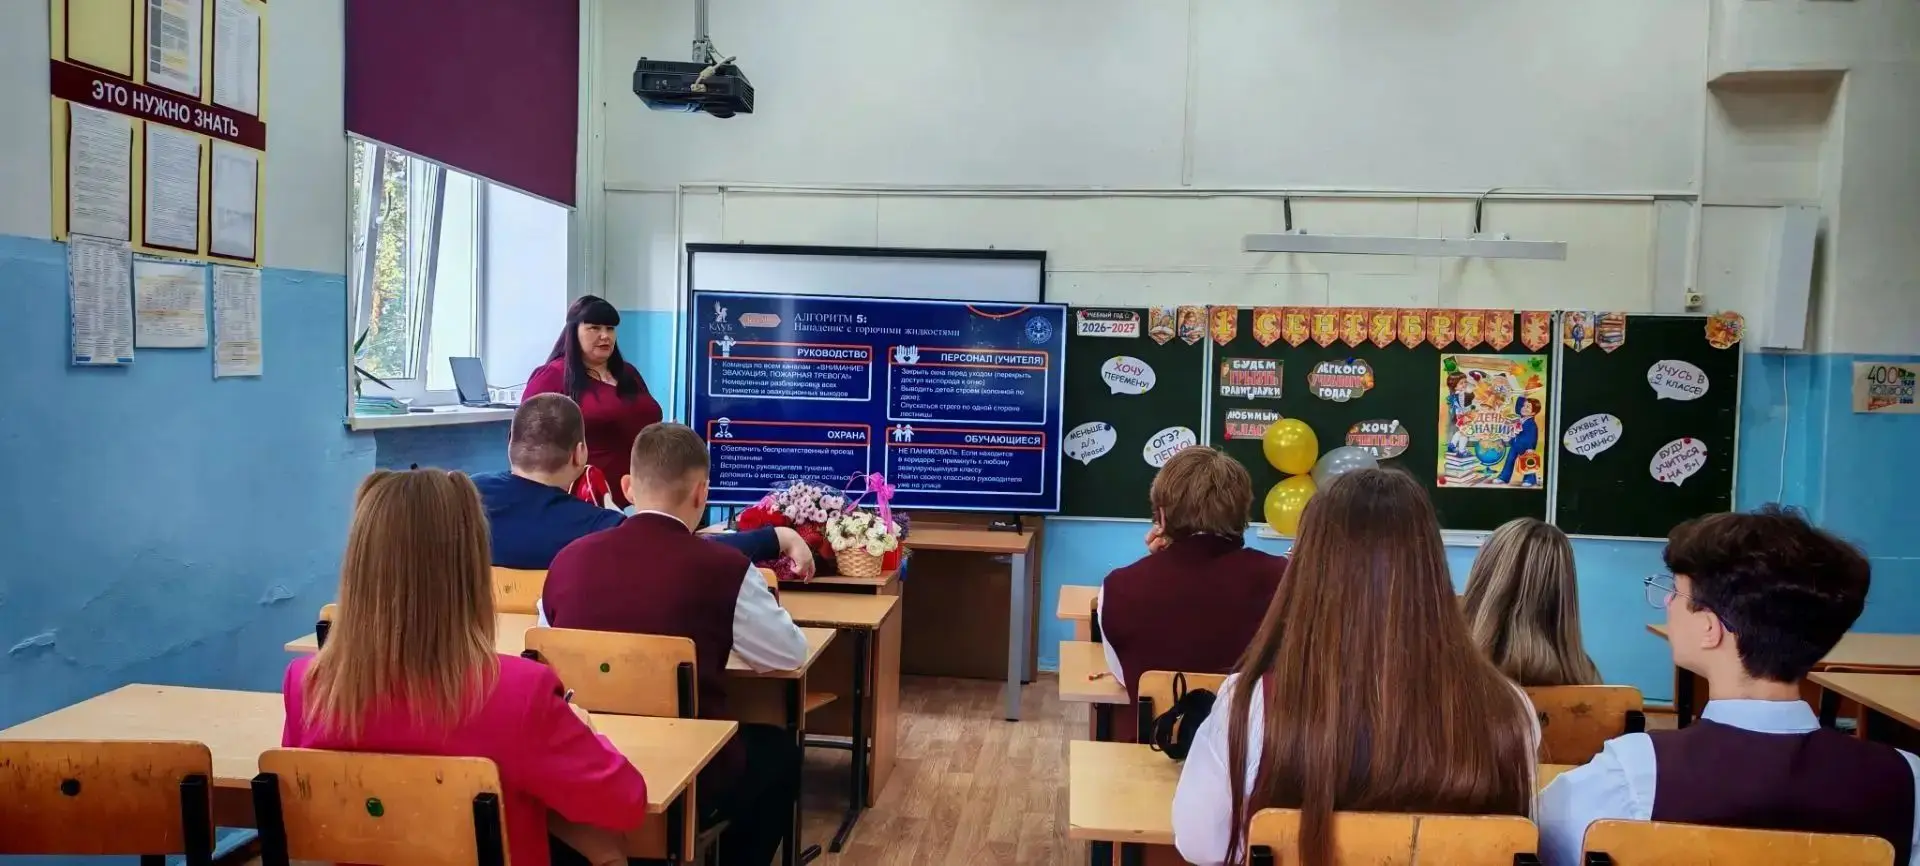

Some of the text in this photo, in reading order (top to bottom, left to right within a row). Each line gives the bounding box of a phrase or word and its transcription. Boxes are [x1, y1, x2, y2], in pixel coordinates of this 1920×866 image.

[92, 79, 240, 138] ЭТО НУЖНО ЗНАТЬ
[793, 312, 868, 324] АЛГОРИТМ 5:
[1216, 310, 1229, 335] 1
[709, 322, 733, 332] КЛУБ
[794, 322, 844, 333] Нападение
[855, 326, 902, 336] горючими
[905, 328, 960, 337] жидкостями
[1082, 322, 1136, 333] 2026-2027
[797, 347, 868, 360] РУКОВОДСТВО
[940, 353, 1045, 366] ПЕРСОНАЛ (УЧИТЕЛЯ)
[1113, 362, 1145, 377] ХОЧУ
[1233, 359, 1276, 370] БУДЕМ
[770, 370, 812, 379] ПОЖАРНАЯ
[1104, 371, 1150, 389] ПЕРЕМЕНУ!
[1656, 363, 1706, 384] УЧУСЬ В
[1477, 411, 1506, 424] ДЕНЬ
[1069, 423, 1104, 441] МЕНЬШЕ
[1361, 422, 1398, 434] ХОЧУ
[1466, 422, 1516, 437] ЗНАНИЙ
[1568, 414, 1610, 436] БУКВЫ И
[827, 430, 866, 441] ОХРАНА
[964, 434, 1042, 446] ОБУЧАЮЩИЕСЯ
[1152, 428, 1181, 449] ОГЭ?
[1575, 432, 1617, 454] ПОМНЮ!
[1658, 440, 1683, 460] БУДУ
[898, 447, 909, 455] НЕ
[1655, 446, 1700, 474] УЧИТЬСЯ
[1666, 468, 1684, 481] НА
